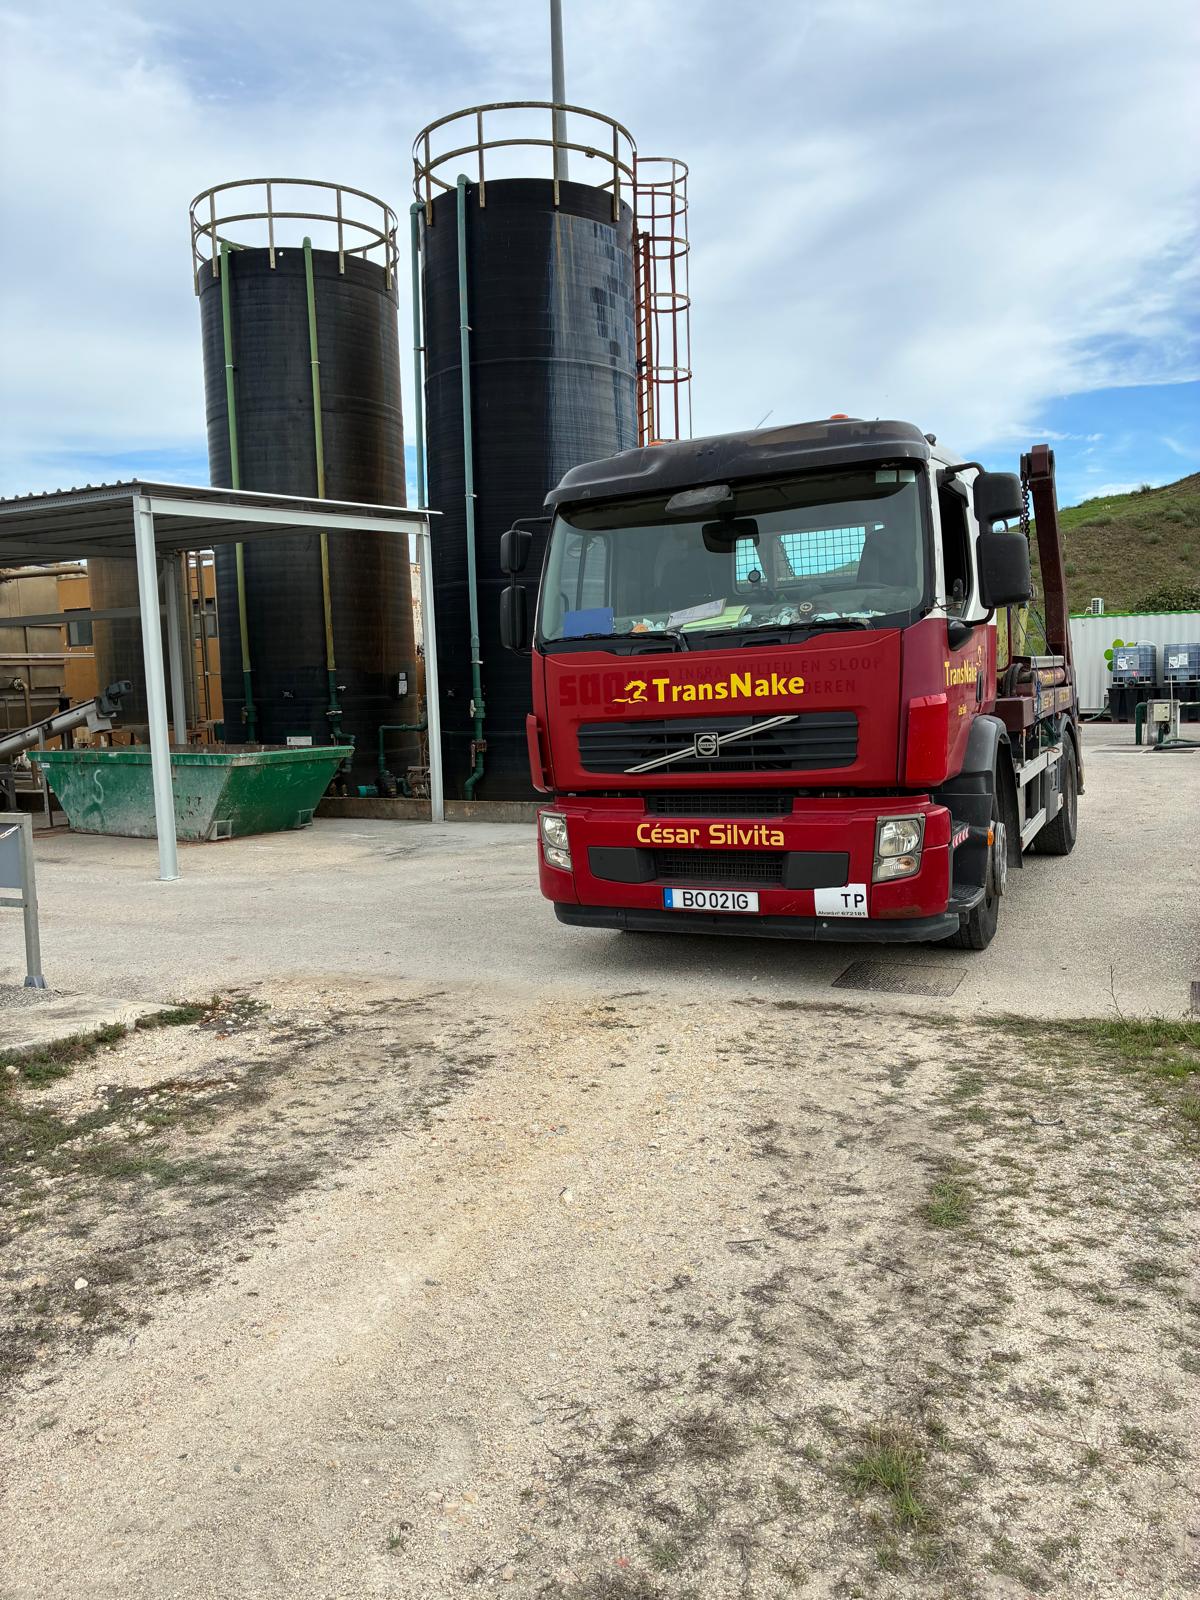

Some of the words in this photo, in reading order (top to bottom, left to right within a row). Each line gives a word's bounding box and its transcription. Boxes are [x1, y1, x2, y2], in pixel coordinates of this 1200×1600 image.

[652, 672, 805, 703] TransNake
[636, 823, 700, 844] César
[708, 824, 785, 846] Silvita
[840, 893, 865, 908] TP
